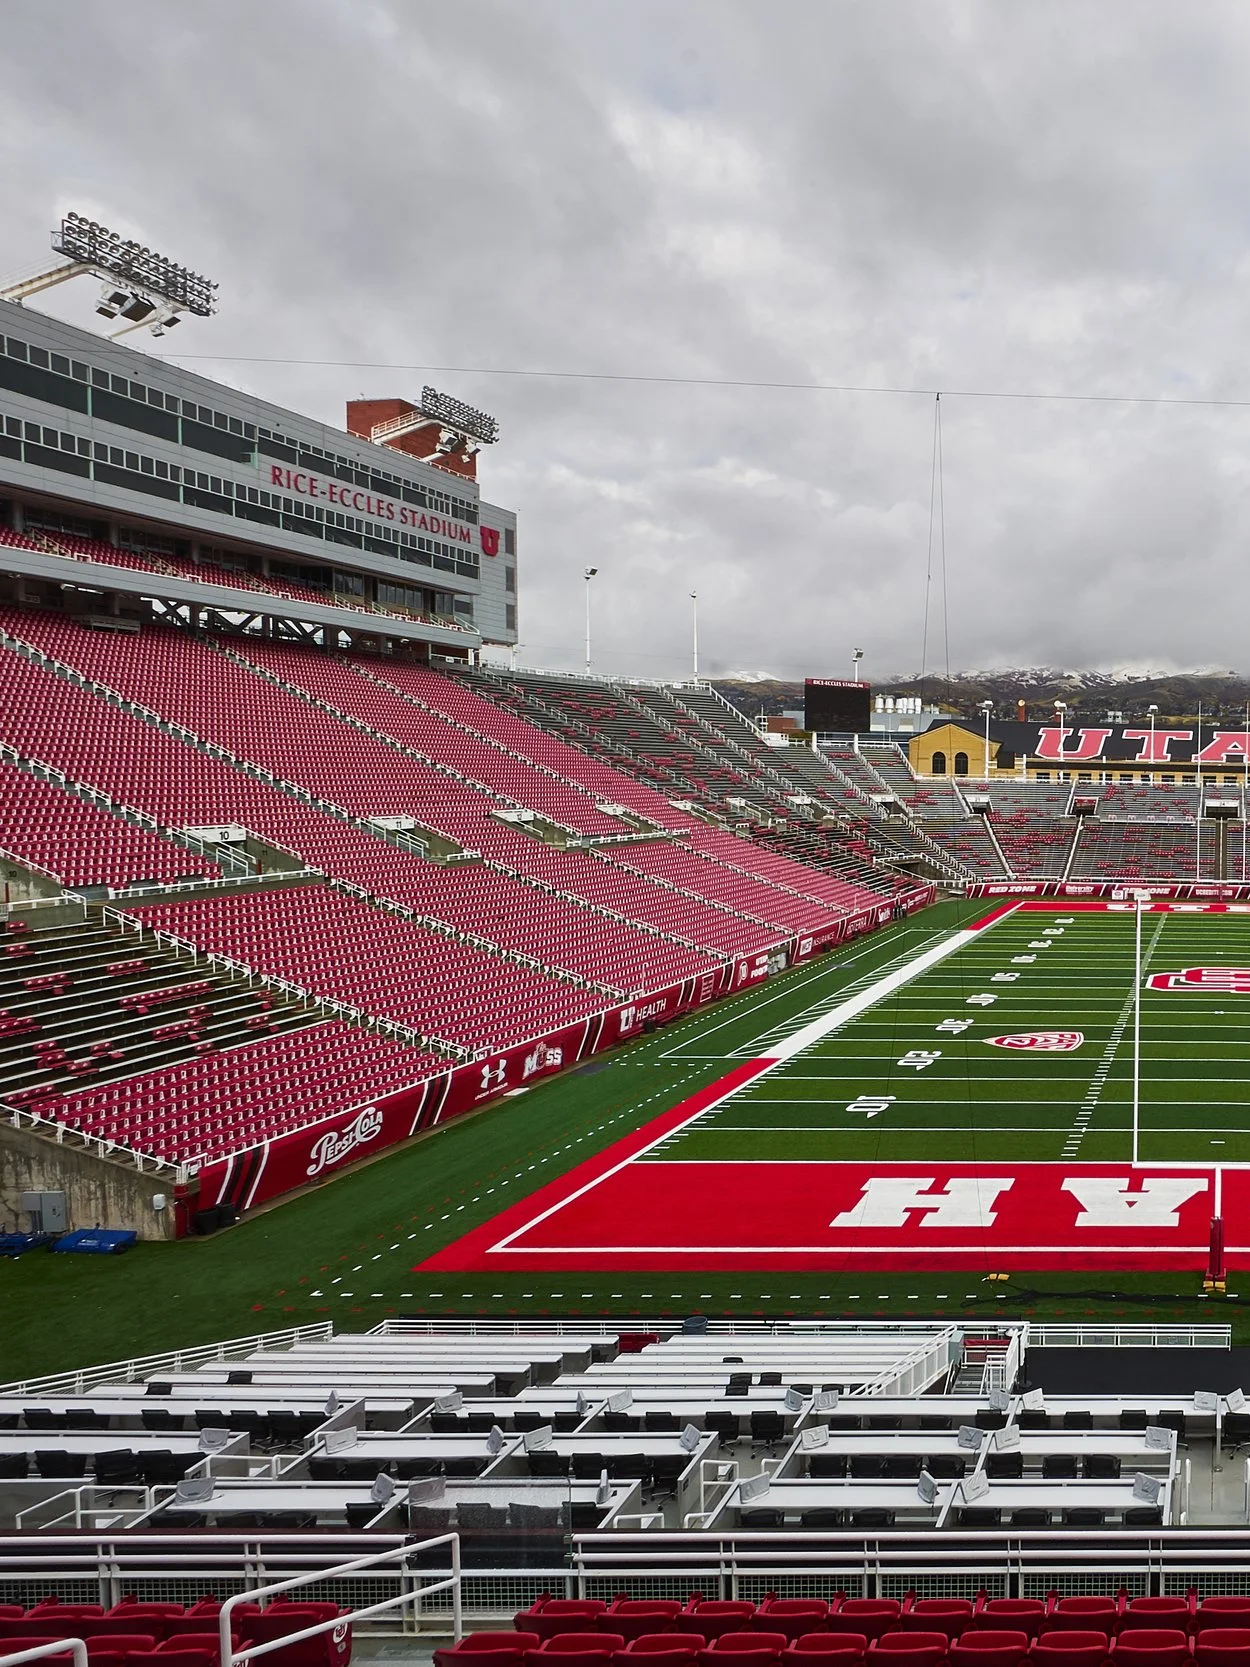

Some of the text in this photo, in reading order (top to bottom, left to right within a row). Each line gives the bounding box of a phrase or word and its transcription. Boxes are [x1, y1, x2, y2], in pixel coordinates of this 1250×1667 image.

[271, 464, 471, 544] RICE-ECCLES STADIUM
[480, 525, 500, 557] U
[219, 831, 230, 841] 10
[988, 886, 1010, 894] RED
[635, 998, 667, 1022] HEALTH
[935, 1018, 974, 1031] 30
[897, 1050, 942, 1066] 20
[845, 1095, 897, 1112] 10
